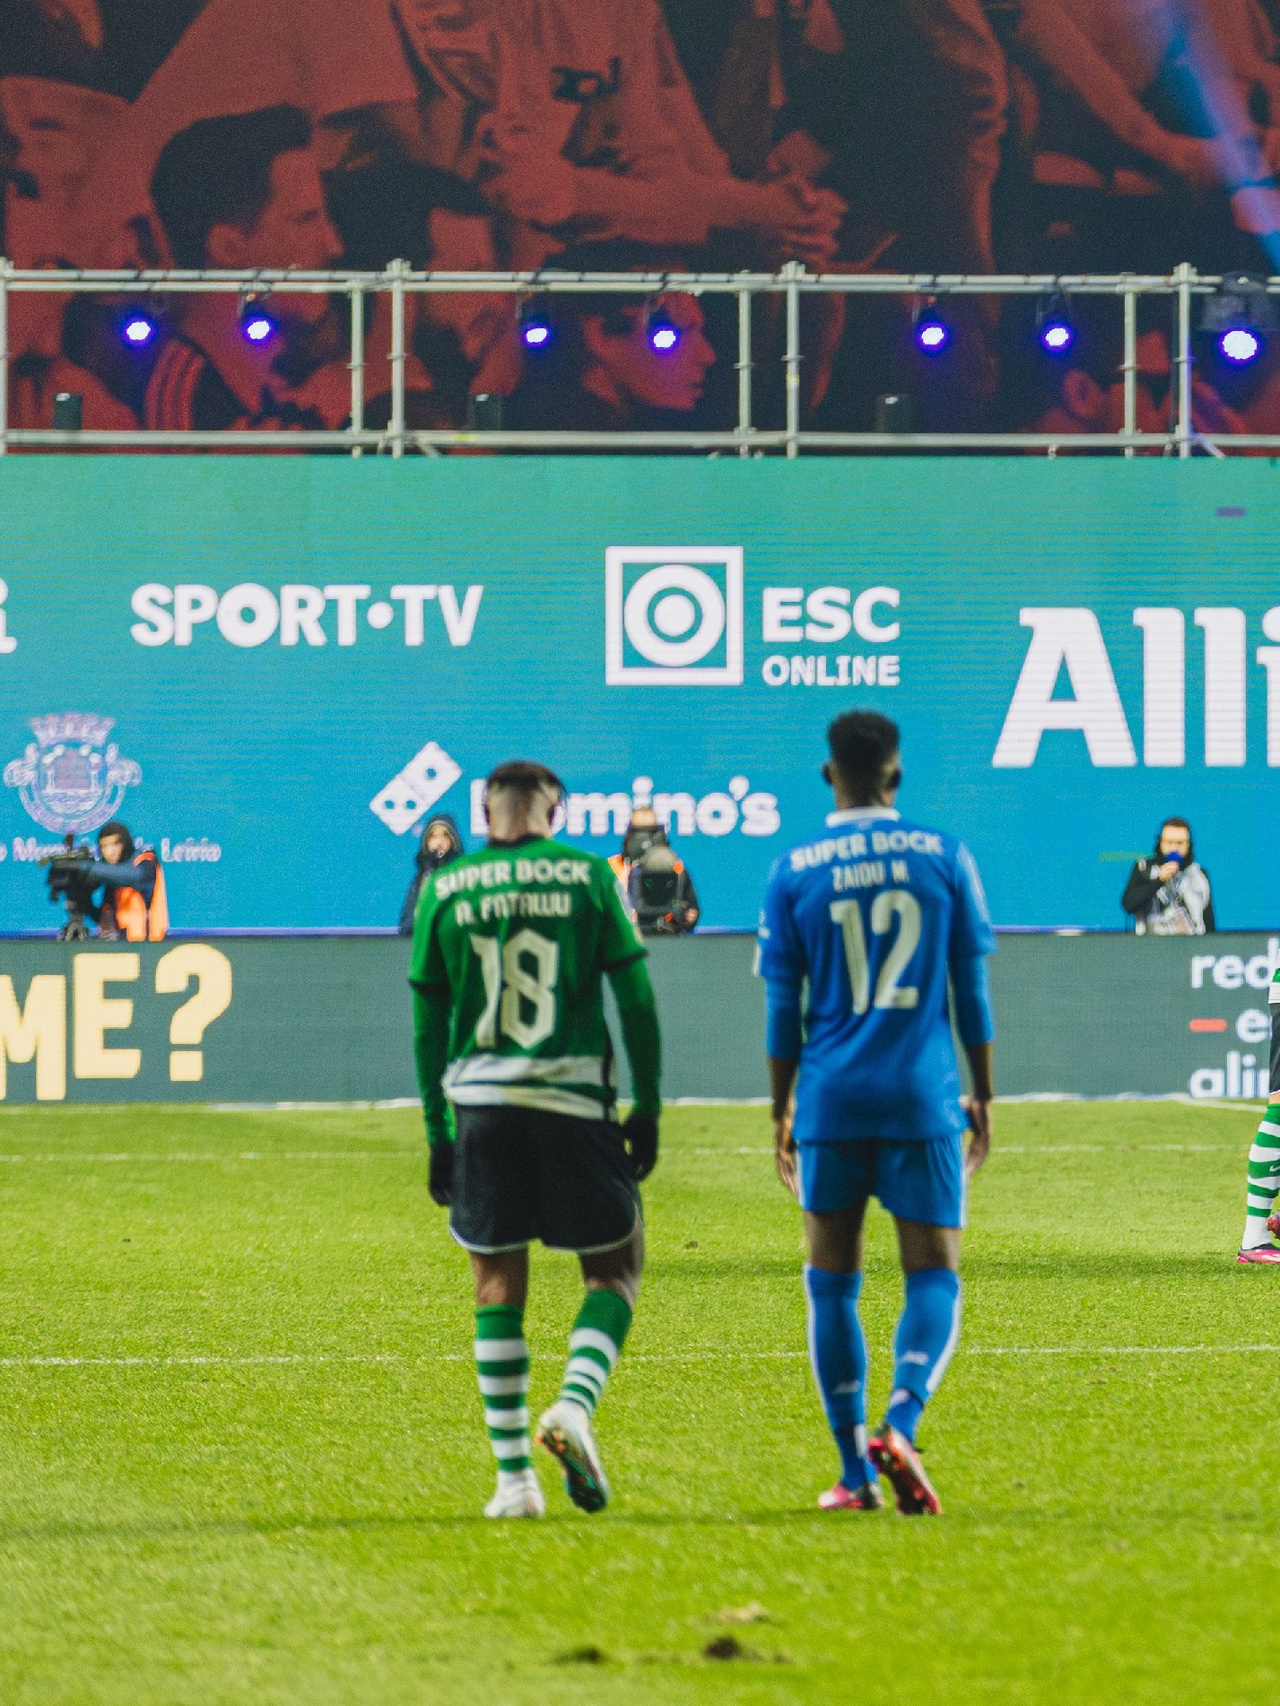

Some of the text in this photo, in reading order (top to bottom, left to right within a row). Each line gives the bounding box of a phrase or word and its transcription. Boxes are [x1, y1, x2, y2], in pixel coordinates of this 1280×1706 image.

[762, 586, 900, 643] ESC
[762, 655, 900, 686] ONLINE
[790, 830, 945, 872] SUPER BOCK
[435, 858, 593, 901] SUPER BOCK
[831, 860, 886, 892] ZAIDU
[829, 888, 922, 1016] 12
[469, 927, 559, 1050] 18
